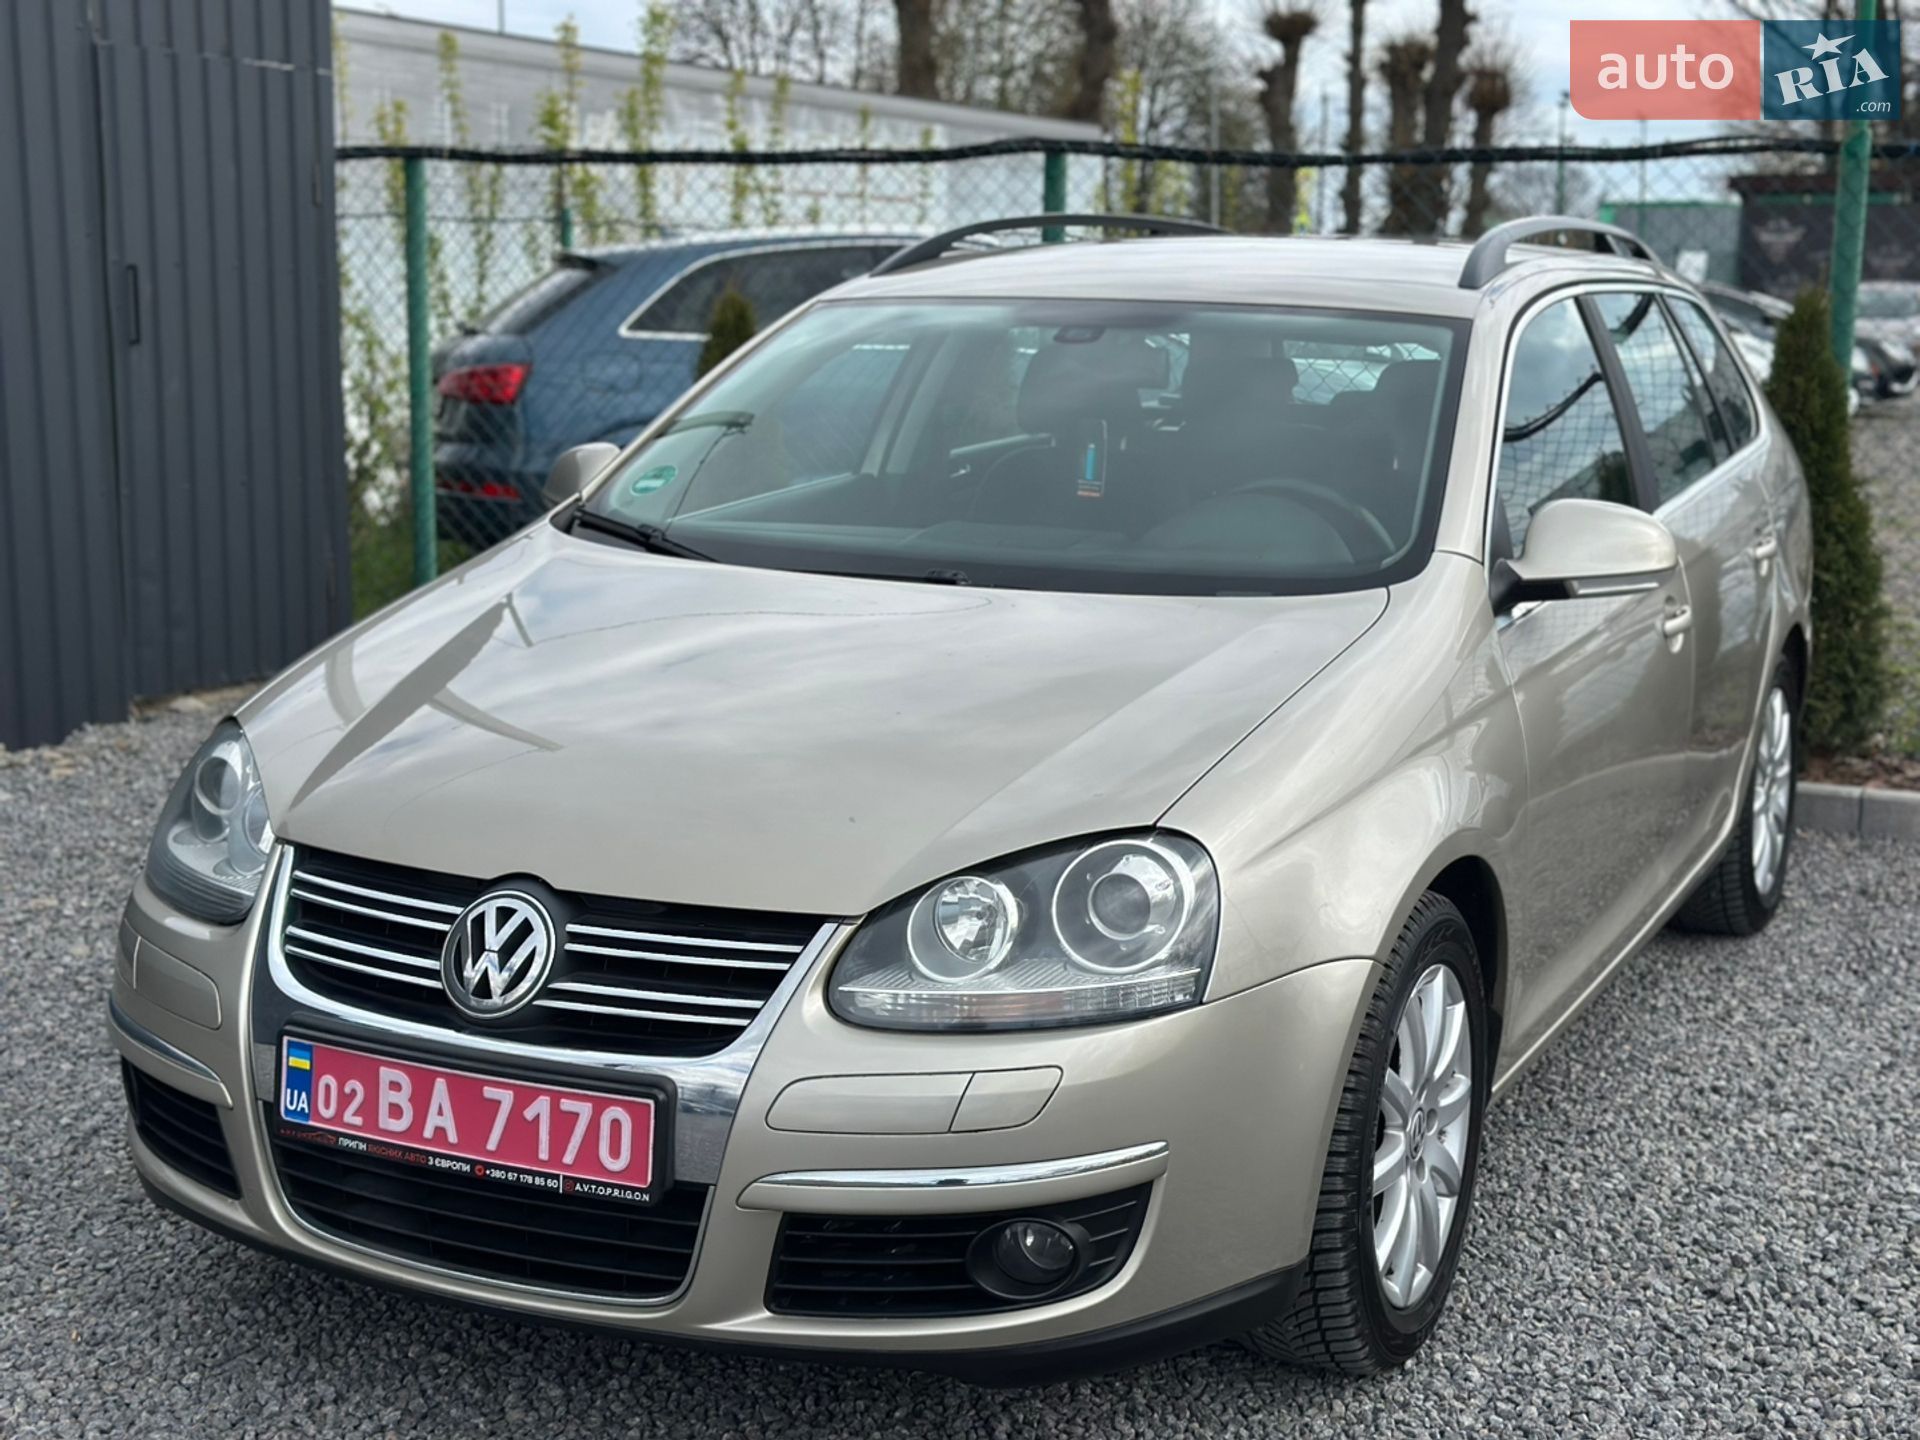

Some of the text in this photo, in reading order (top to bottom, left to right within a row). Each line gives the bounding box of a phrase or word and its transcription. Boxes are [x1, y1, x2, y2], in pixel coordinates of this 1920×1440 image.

[286, 1088, 309, 1113] UA
[317, 1074, 365, 1126] 02
[482, 1085, 633, 1173] 7170
